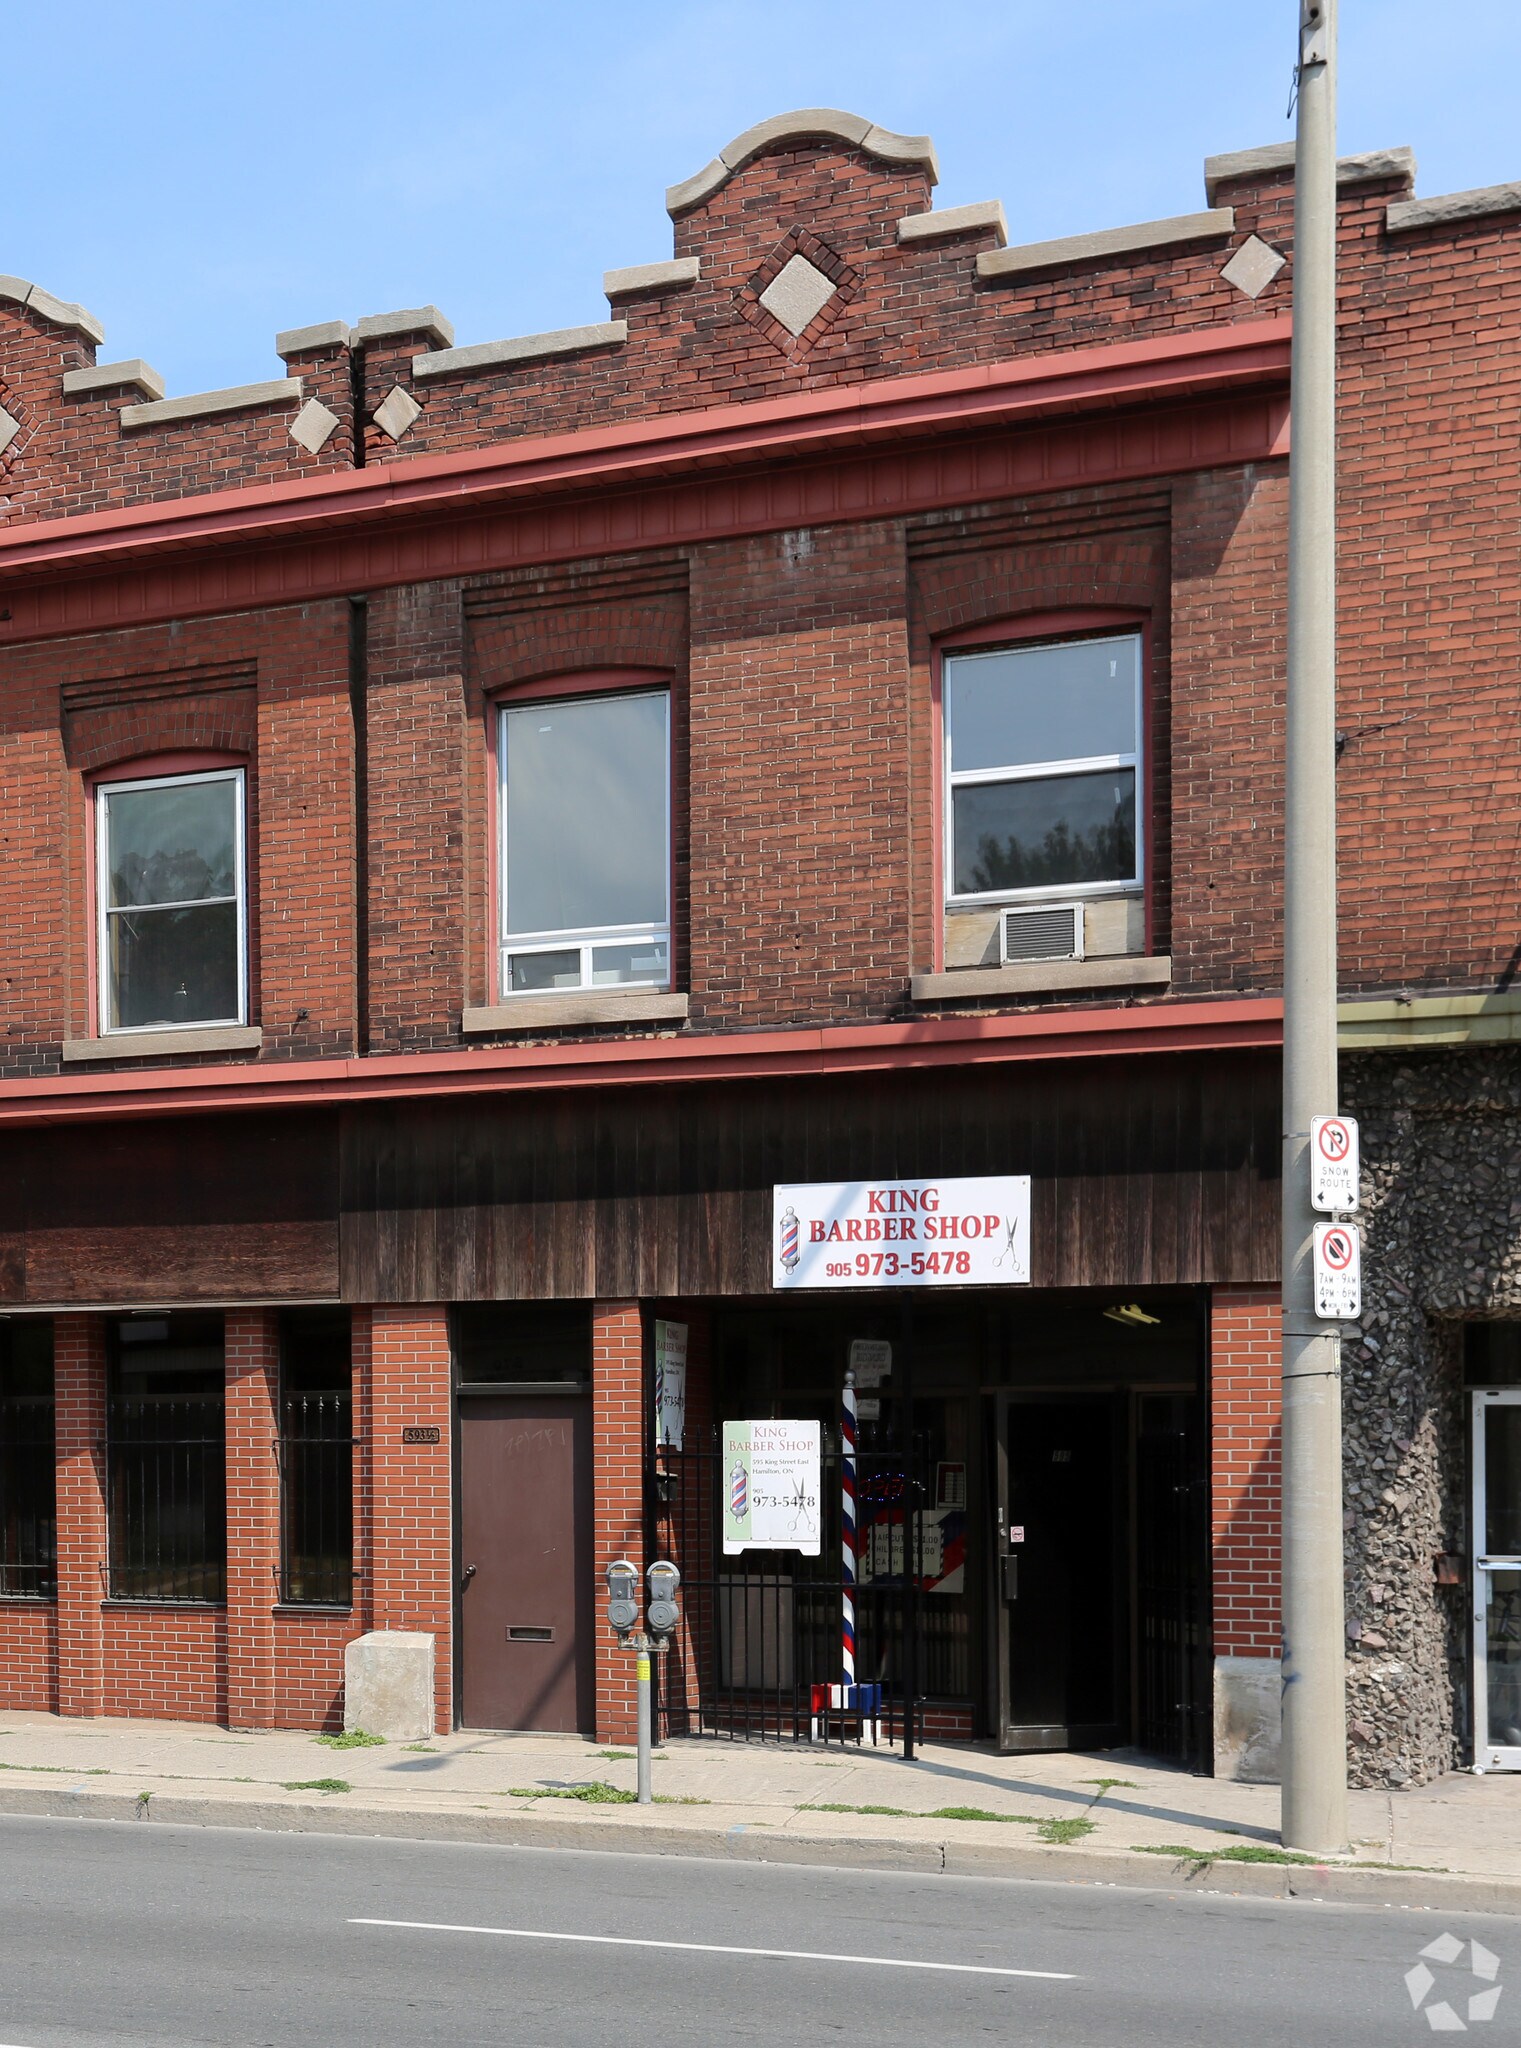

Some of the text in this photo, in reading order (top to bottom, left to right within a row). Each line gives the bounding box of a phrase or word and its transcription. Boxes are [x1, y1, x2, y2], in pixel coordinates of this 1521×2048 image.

[1322, 1166, 1349, 1176] SNOW
[1320, 1179, 1351, 1189] ROUTE
[867, 1188, 940, 1214] KING
[809, 1215, 1000, 1242] BARBER SHOP
[826, 1251, 971, 1277] 905 973-5478
[1319, 1272, 1334, 1284] 7AM
[1341, 1273, 1356, 1284] 9AM
[1320, 1286, 1334, 1297] 4PM
[1342, 1287, 1357, 1298] 6PM
[754, 1426, 787, 1438] KING
[729, 1439, 814, 1451] BARBER SHOP
[753, 1496, 815, 1507] 973-5478
